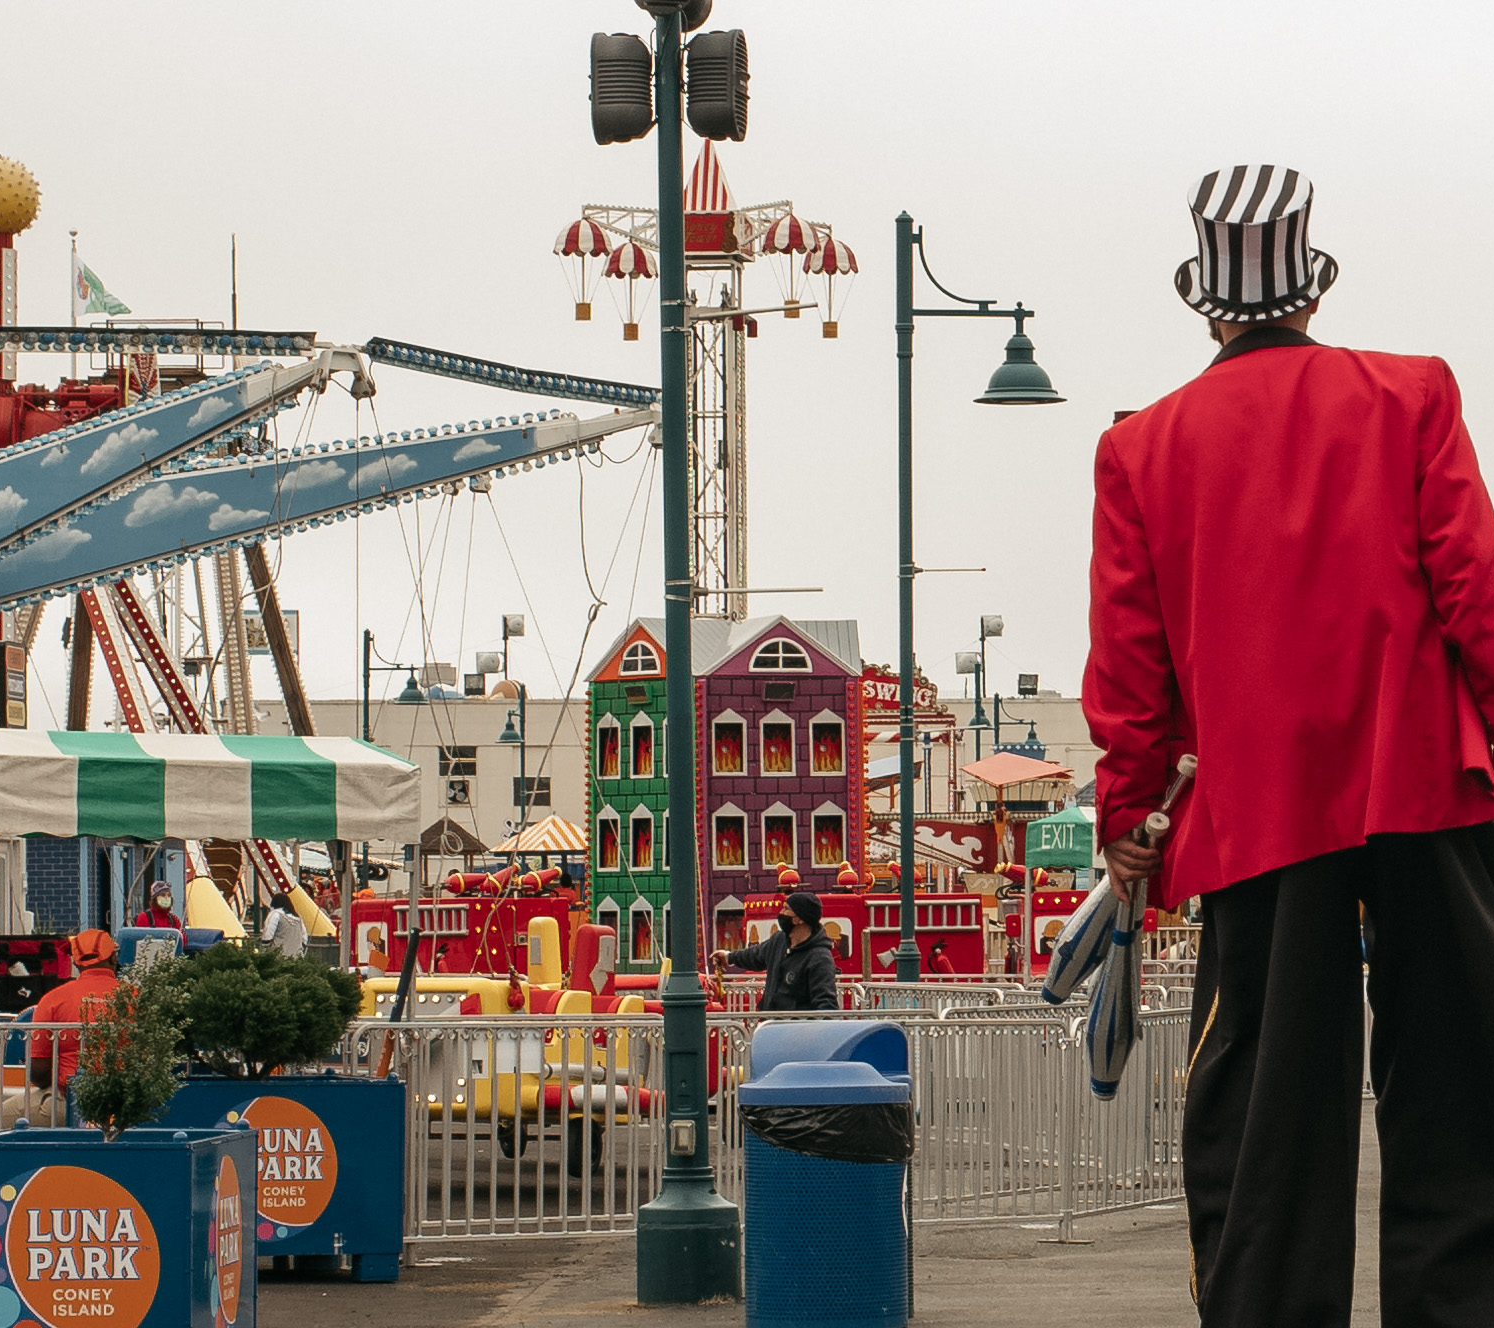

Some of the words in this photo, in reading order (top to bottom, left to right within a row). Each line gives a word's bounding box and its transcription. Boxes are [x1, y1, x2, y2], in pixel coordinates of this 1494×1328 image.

[1041, 824, 1076, 850] EXIT
[263, 1185, 305, 1196] CONEY
[263, 1197, 306, 1208] ISLAND
[219, 1194, 240, 1230] LUNA
[27, 1208, 140, 1243] LUNA
[219, 1230, 240, 1267] PARK
[27, 1246, 140, 1280] PARK
[52, 1288, 113, 1301] CONEY
[52, 1303, 115, 1317] ISLAND
